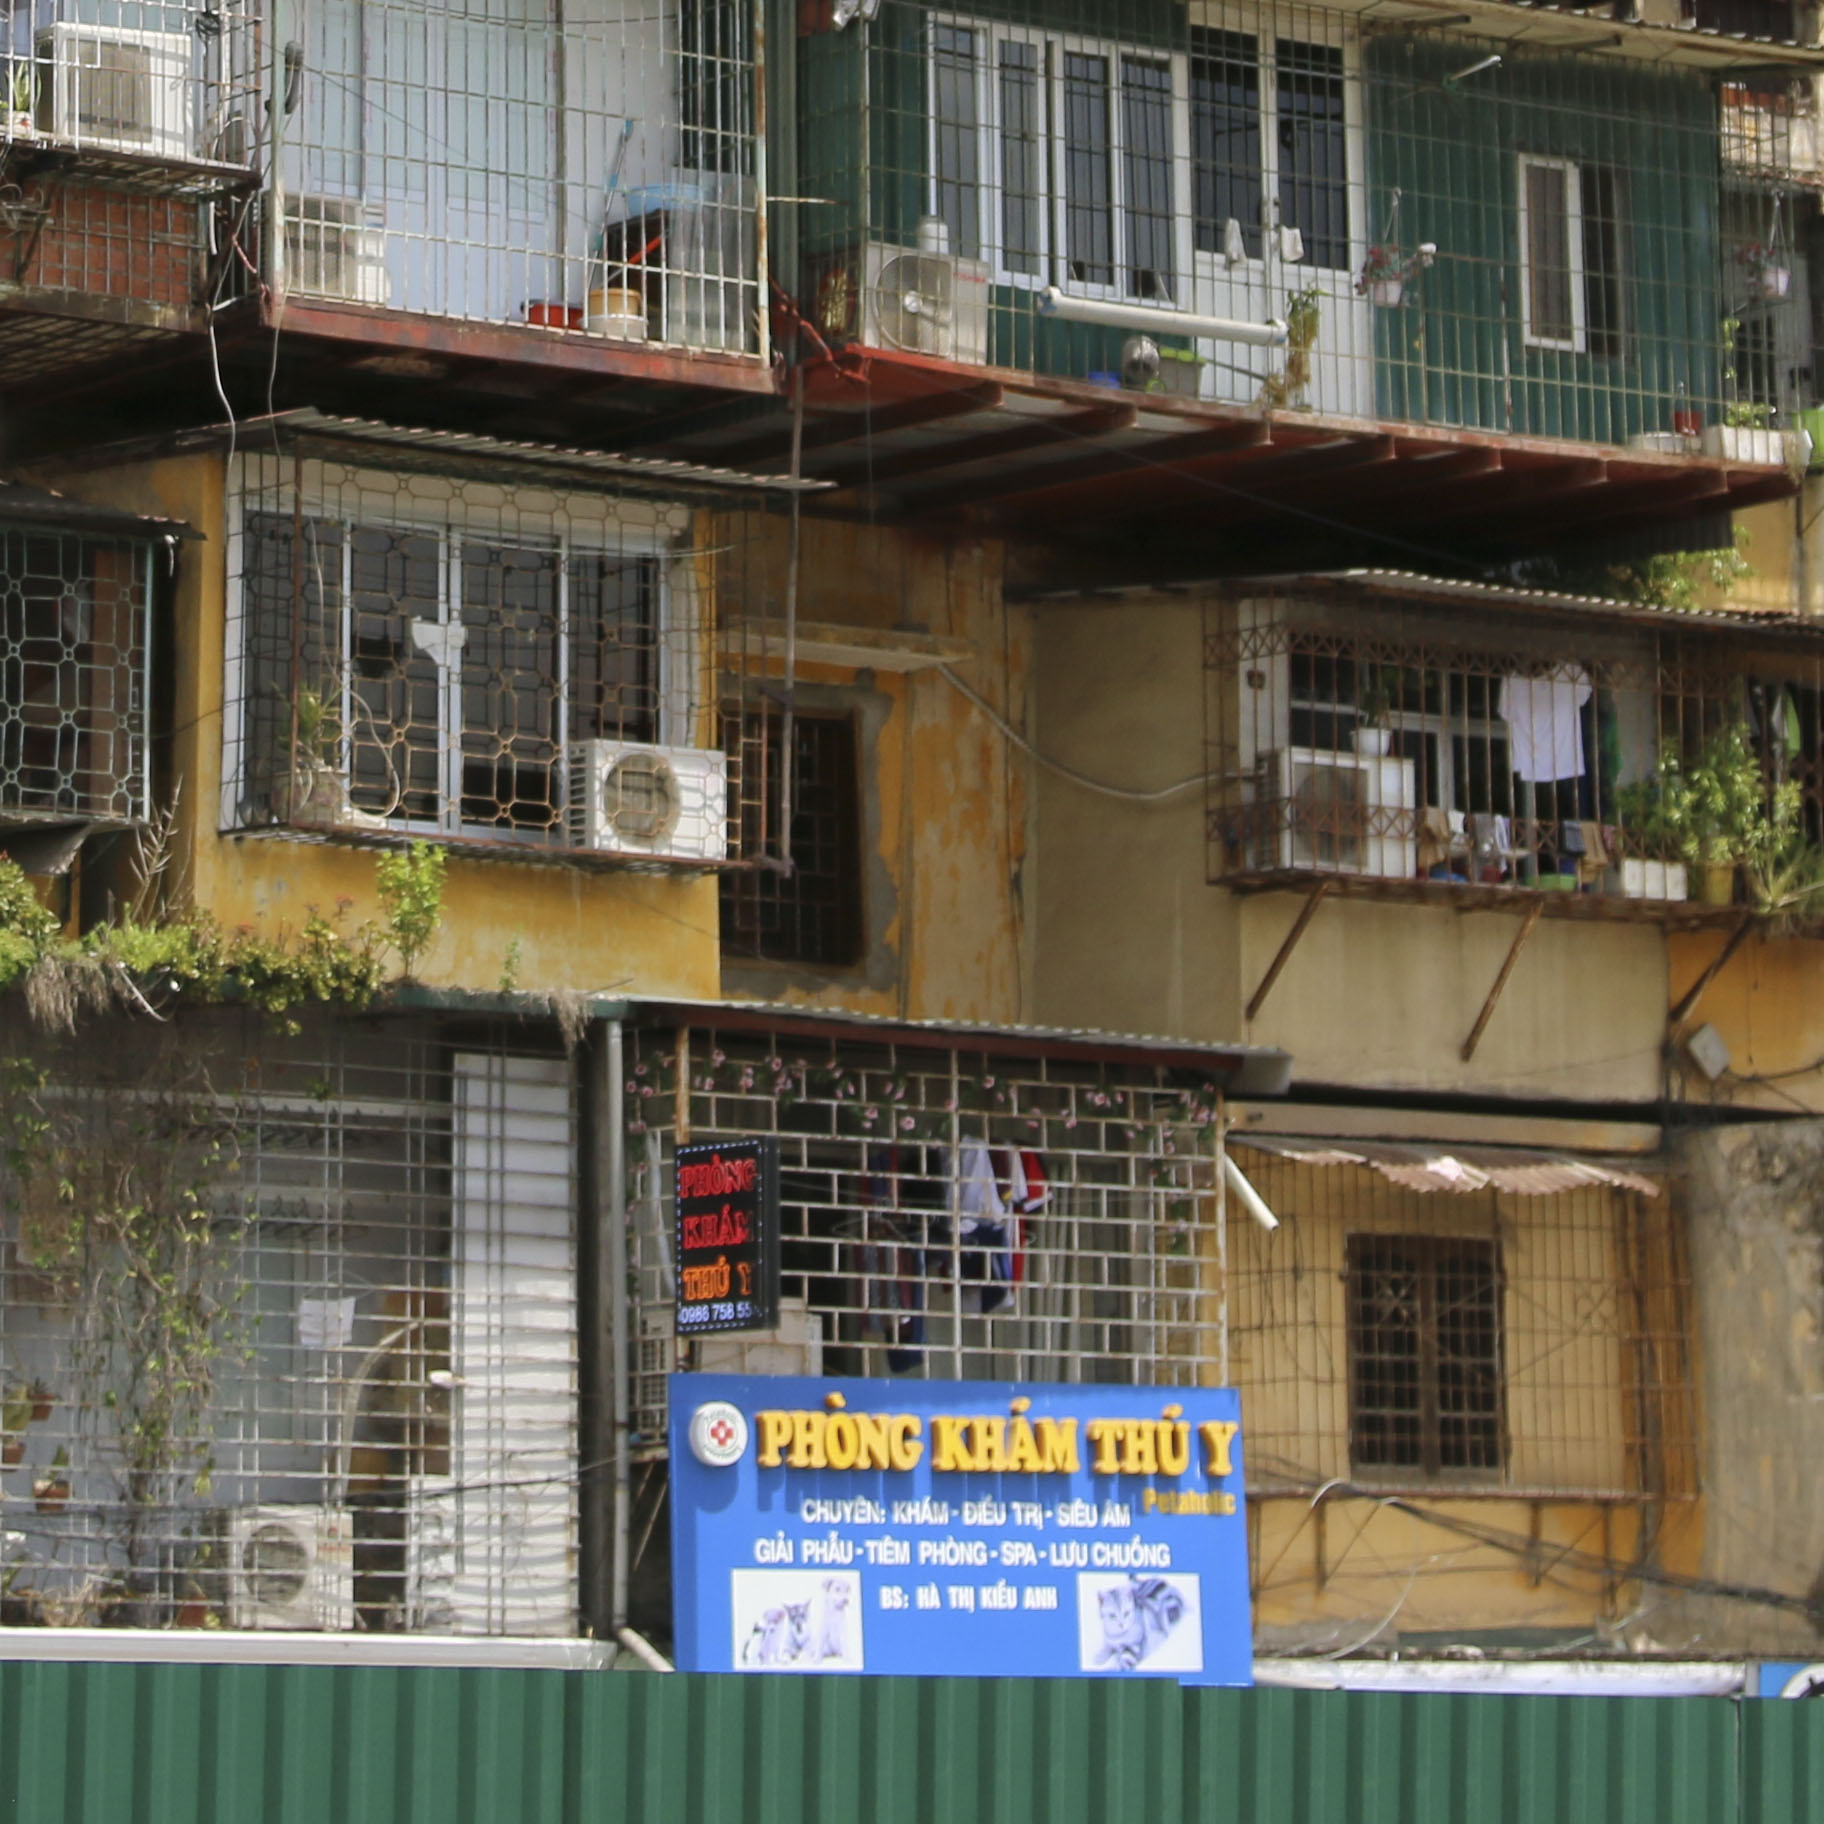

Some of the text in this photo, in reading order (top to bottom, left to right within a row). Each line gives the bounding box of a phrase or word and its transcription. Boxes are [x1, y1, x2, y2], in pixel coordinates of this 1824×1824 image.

[755, 1391, 924, 1470] PHÒNG
[930, 1397, 1081, 1473] KHÁM
[1087, 1404, 1191, 1476] THÚ
[1198, 1420, 1239, 1476] Y
[892, 1496, 949, 1525] KHÁM
[1000, 1541, 1038, 1566] SPA
[1023, 1586, 1058, 1610] ANH
